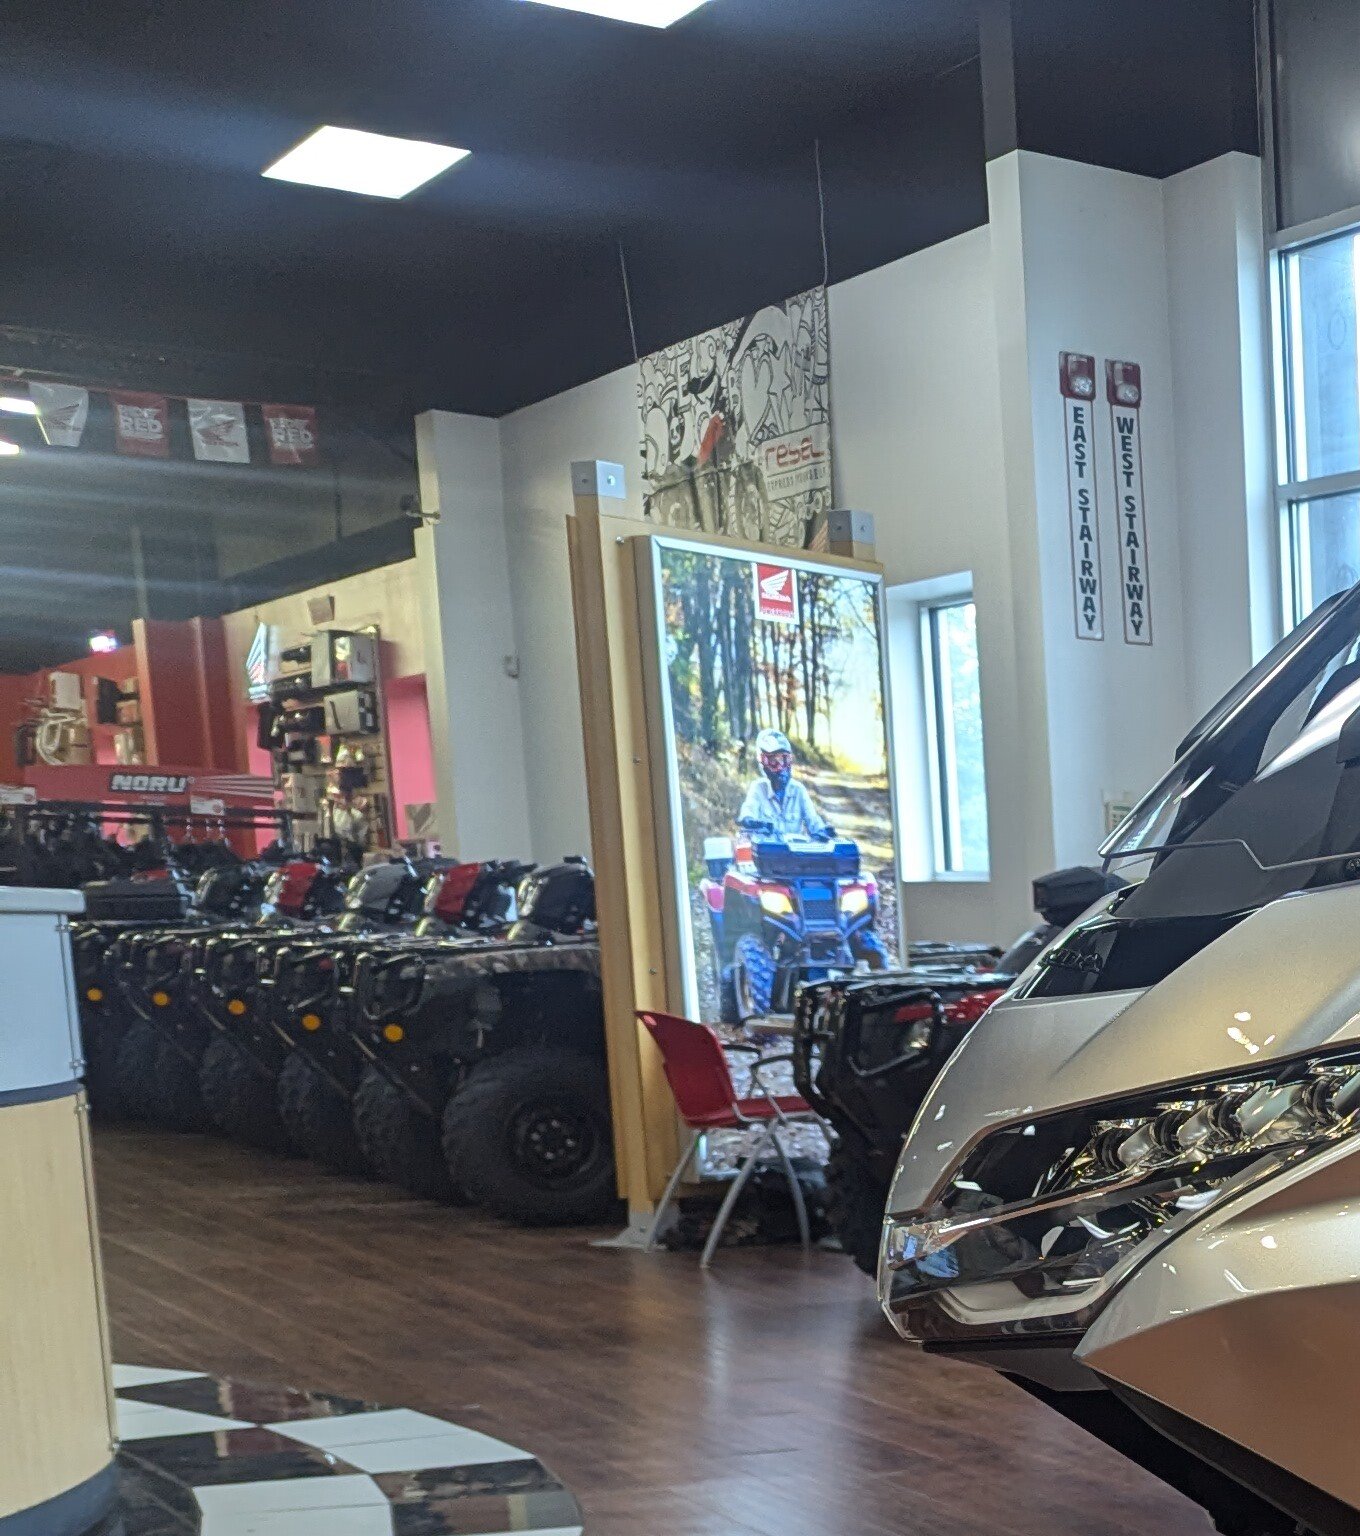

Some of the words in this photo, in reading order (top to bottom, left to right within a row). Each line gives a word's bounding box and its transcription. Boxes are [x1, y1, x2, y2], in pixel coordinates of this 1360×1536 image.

[1072, 406, 1087, 479] EAST
[1116, 416, 1135, 488] WEST
[1078, 488, 1097, 631] STAIRWAY
[1124, 495, 1144, 636] STAIRWAY
[111, 774, 187, 793] NORU
